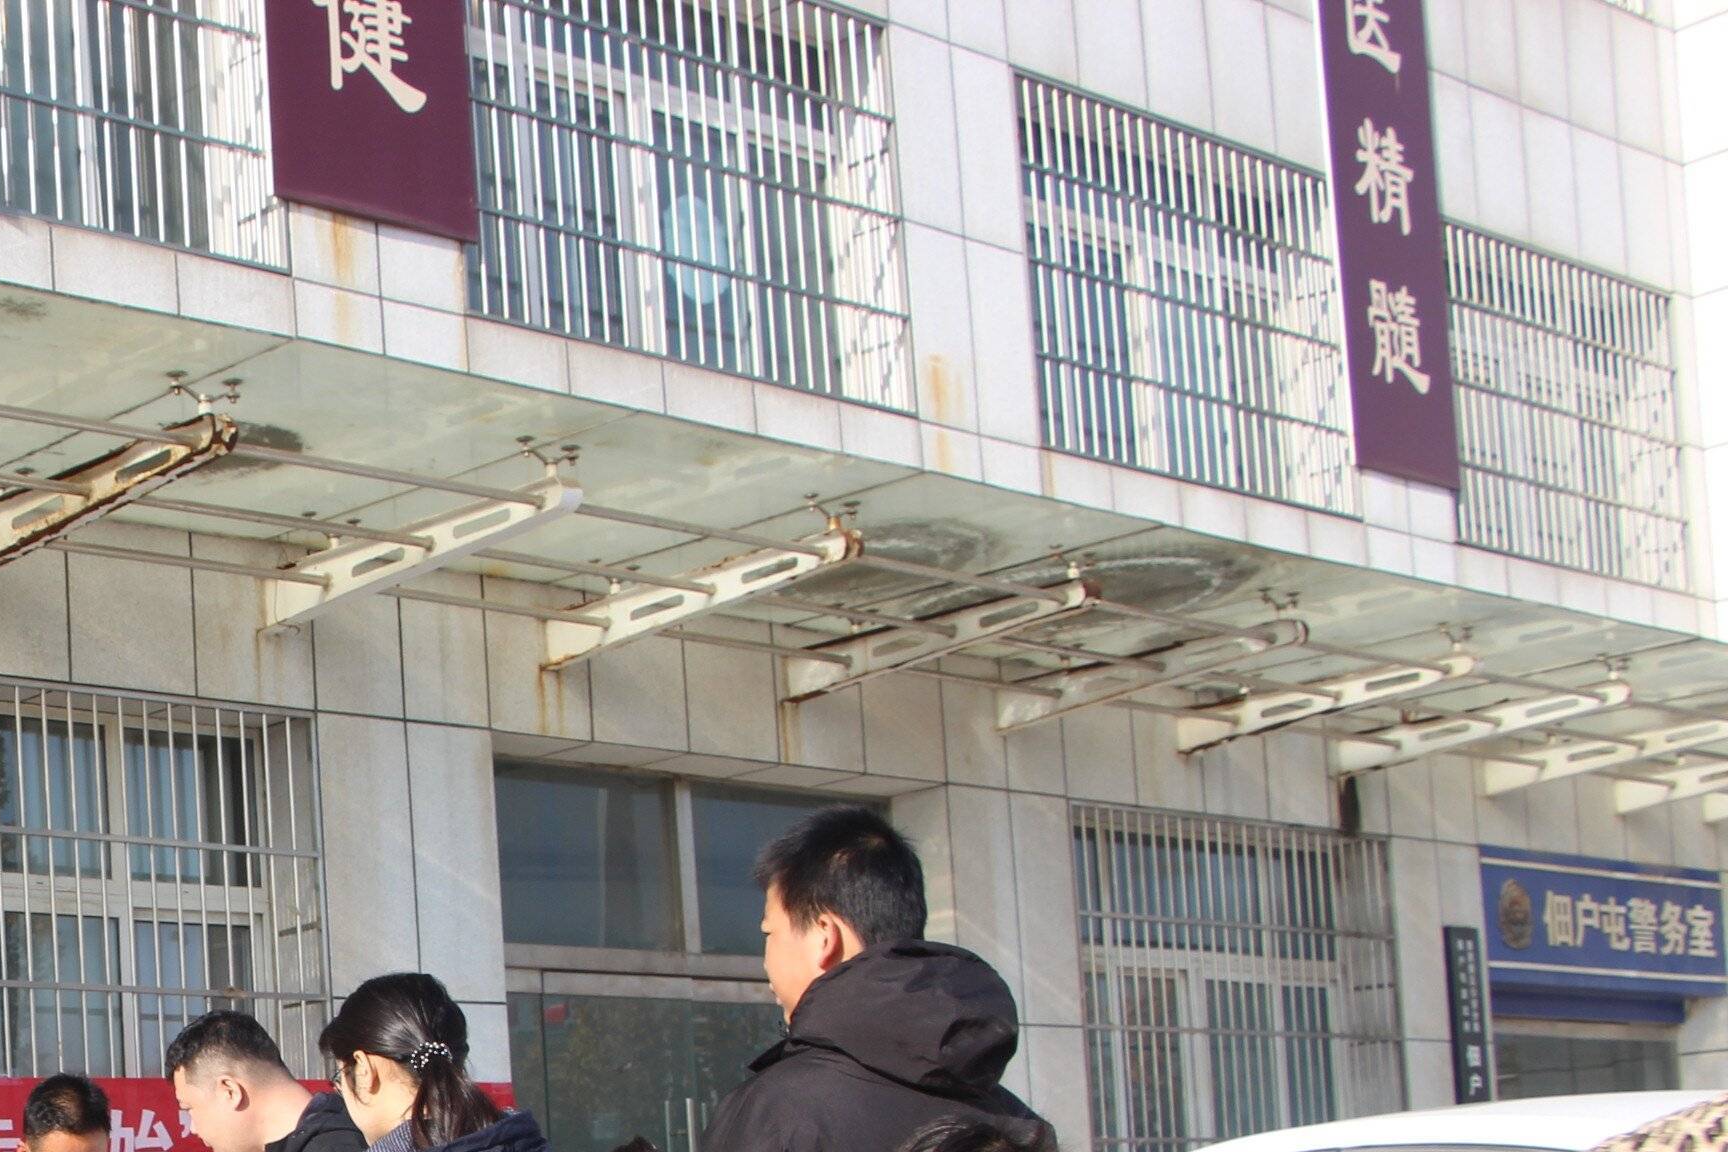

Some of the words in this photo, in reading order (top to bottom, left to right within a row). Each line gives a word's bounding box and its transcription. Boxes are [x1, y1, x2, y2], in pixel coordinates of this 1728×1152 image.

[311, 0, 427, 113] 健
[1542, 889, 1718, 959] 佃户屯警务室
